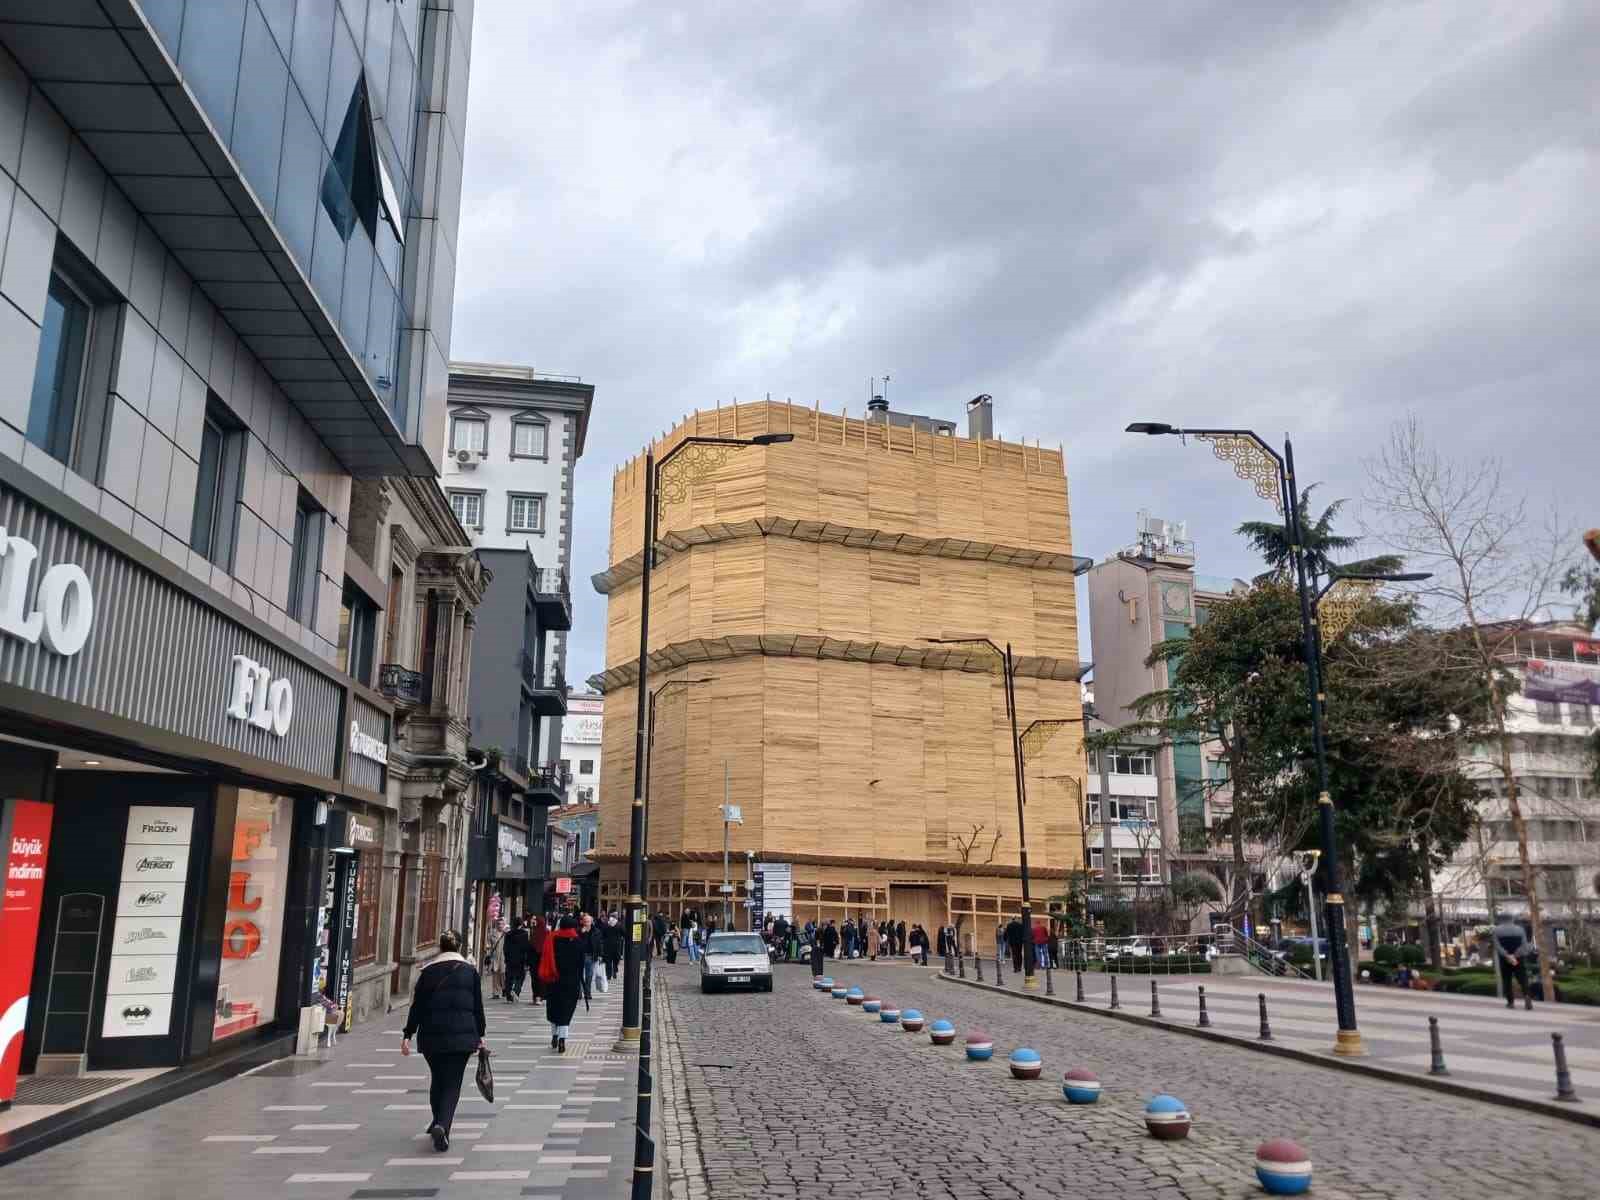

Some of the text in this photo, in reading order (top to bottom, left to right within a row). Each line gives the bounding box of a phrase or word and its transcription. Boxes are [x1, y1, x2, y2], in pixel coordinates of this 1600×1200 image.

[0, 526, 94, 656] LO
[227, 653, 293, 737] FLO
[12, 837, 43, 857] büyük
[142, 823, 177, 833] FROZEN
[8, 862, 44, 880] indirim
[345, 859, 357, 928] TURKCELL
